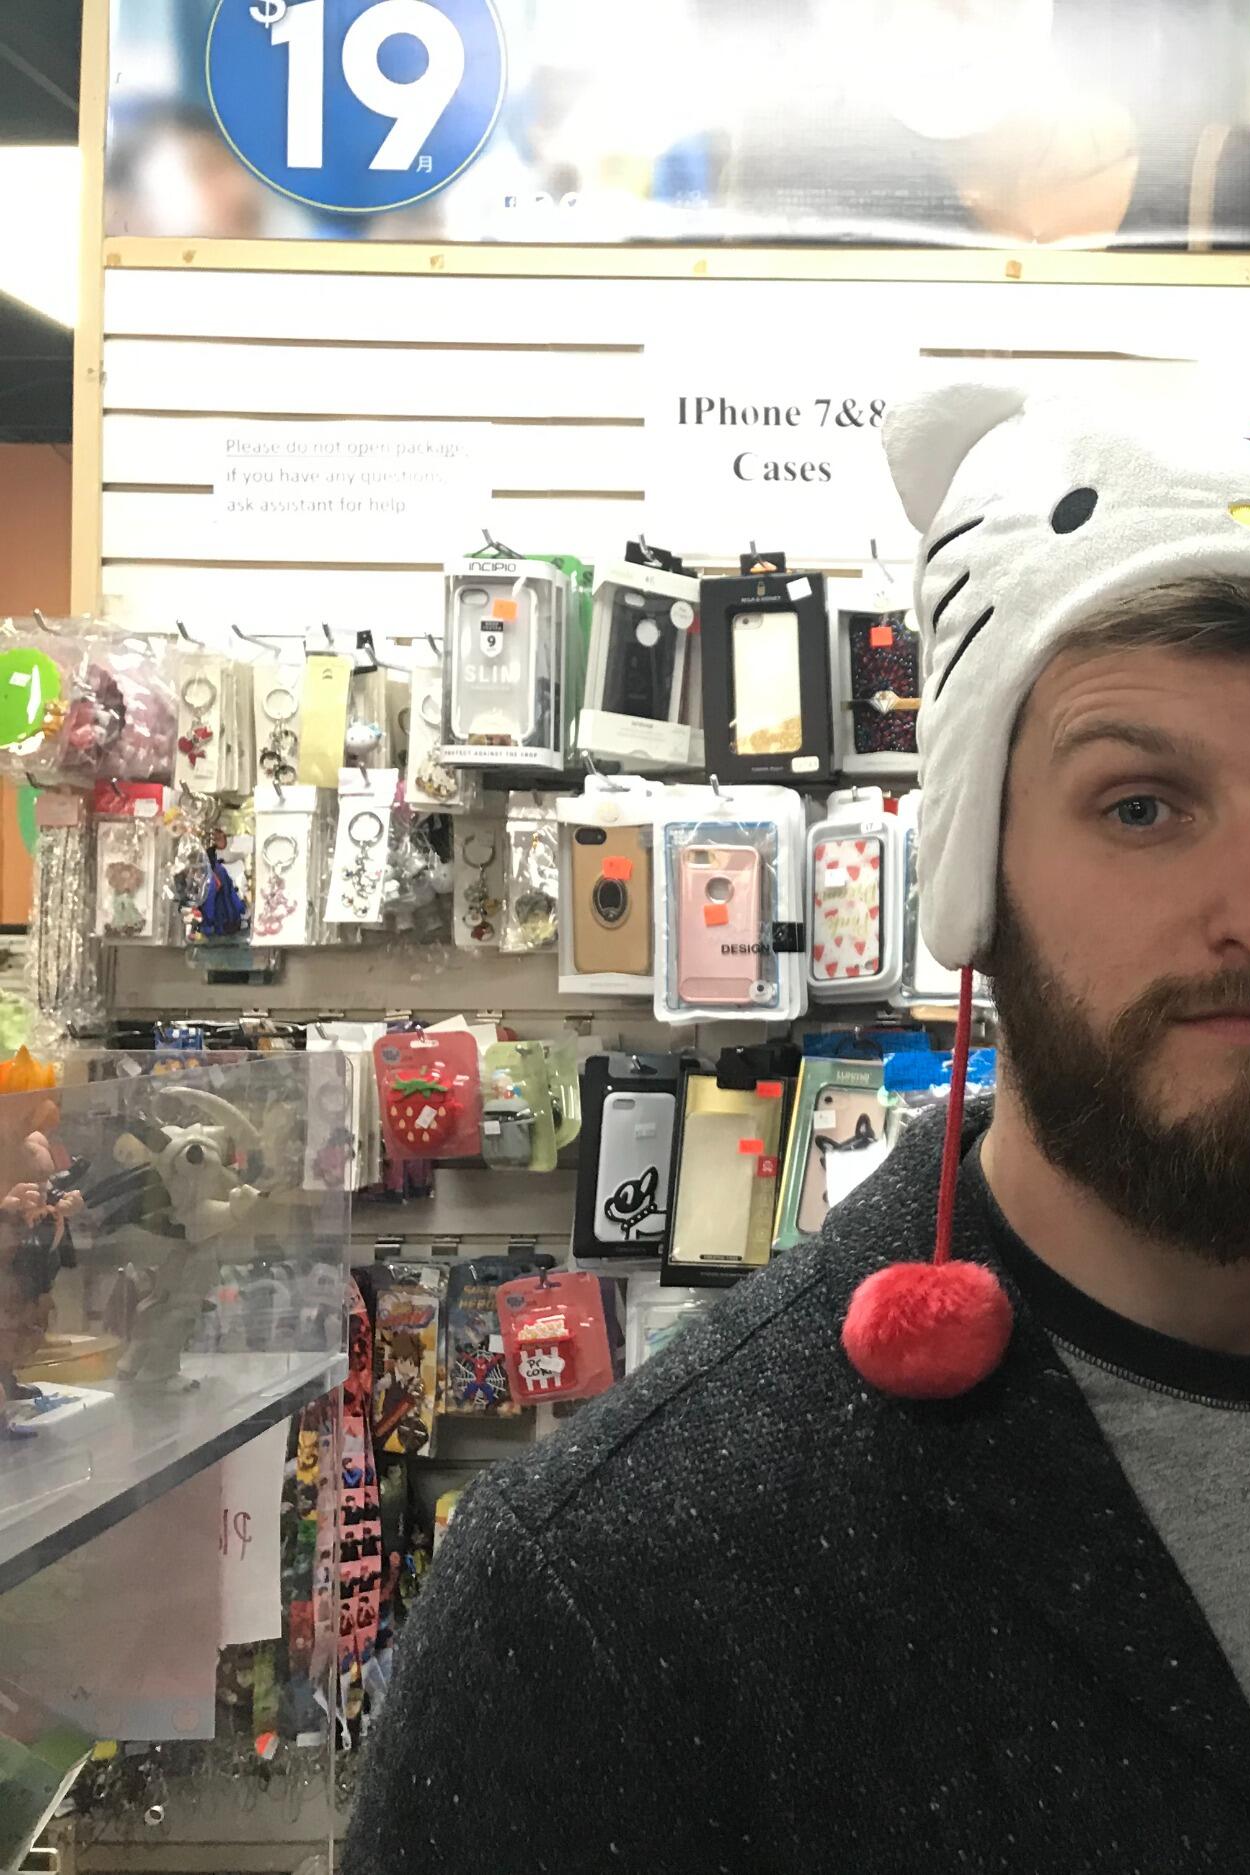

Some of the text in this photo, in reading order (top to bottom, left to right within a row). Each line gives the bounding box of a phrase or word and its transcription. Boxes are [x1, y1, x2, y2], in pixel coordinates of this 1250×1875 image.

[678, 396, 887, 429] IPhone 7&8
[226, 439, 281, 455] Please
[286, 440, 307, 454] do
[313, 441, 341, 454] not
[347, 442, 390, 458] open
[226, 467, 237, 482] if
[243, 471, 274, 485] you
[280, 467, 319, 483] have
[325, 471, 355, 485] any
[732, 452, 833, 483] Cases
[227, 498, 254, 513] ask
[260, 499, 333, 513] assistant
[340, 497, 363, 512] for
[487, 635, 497, 647] 9
[721, 943, 770, 955] DESIGN
